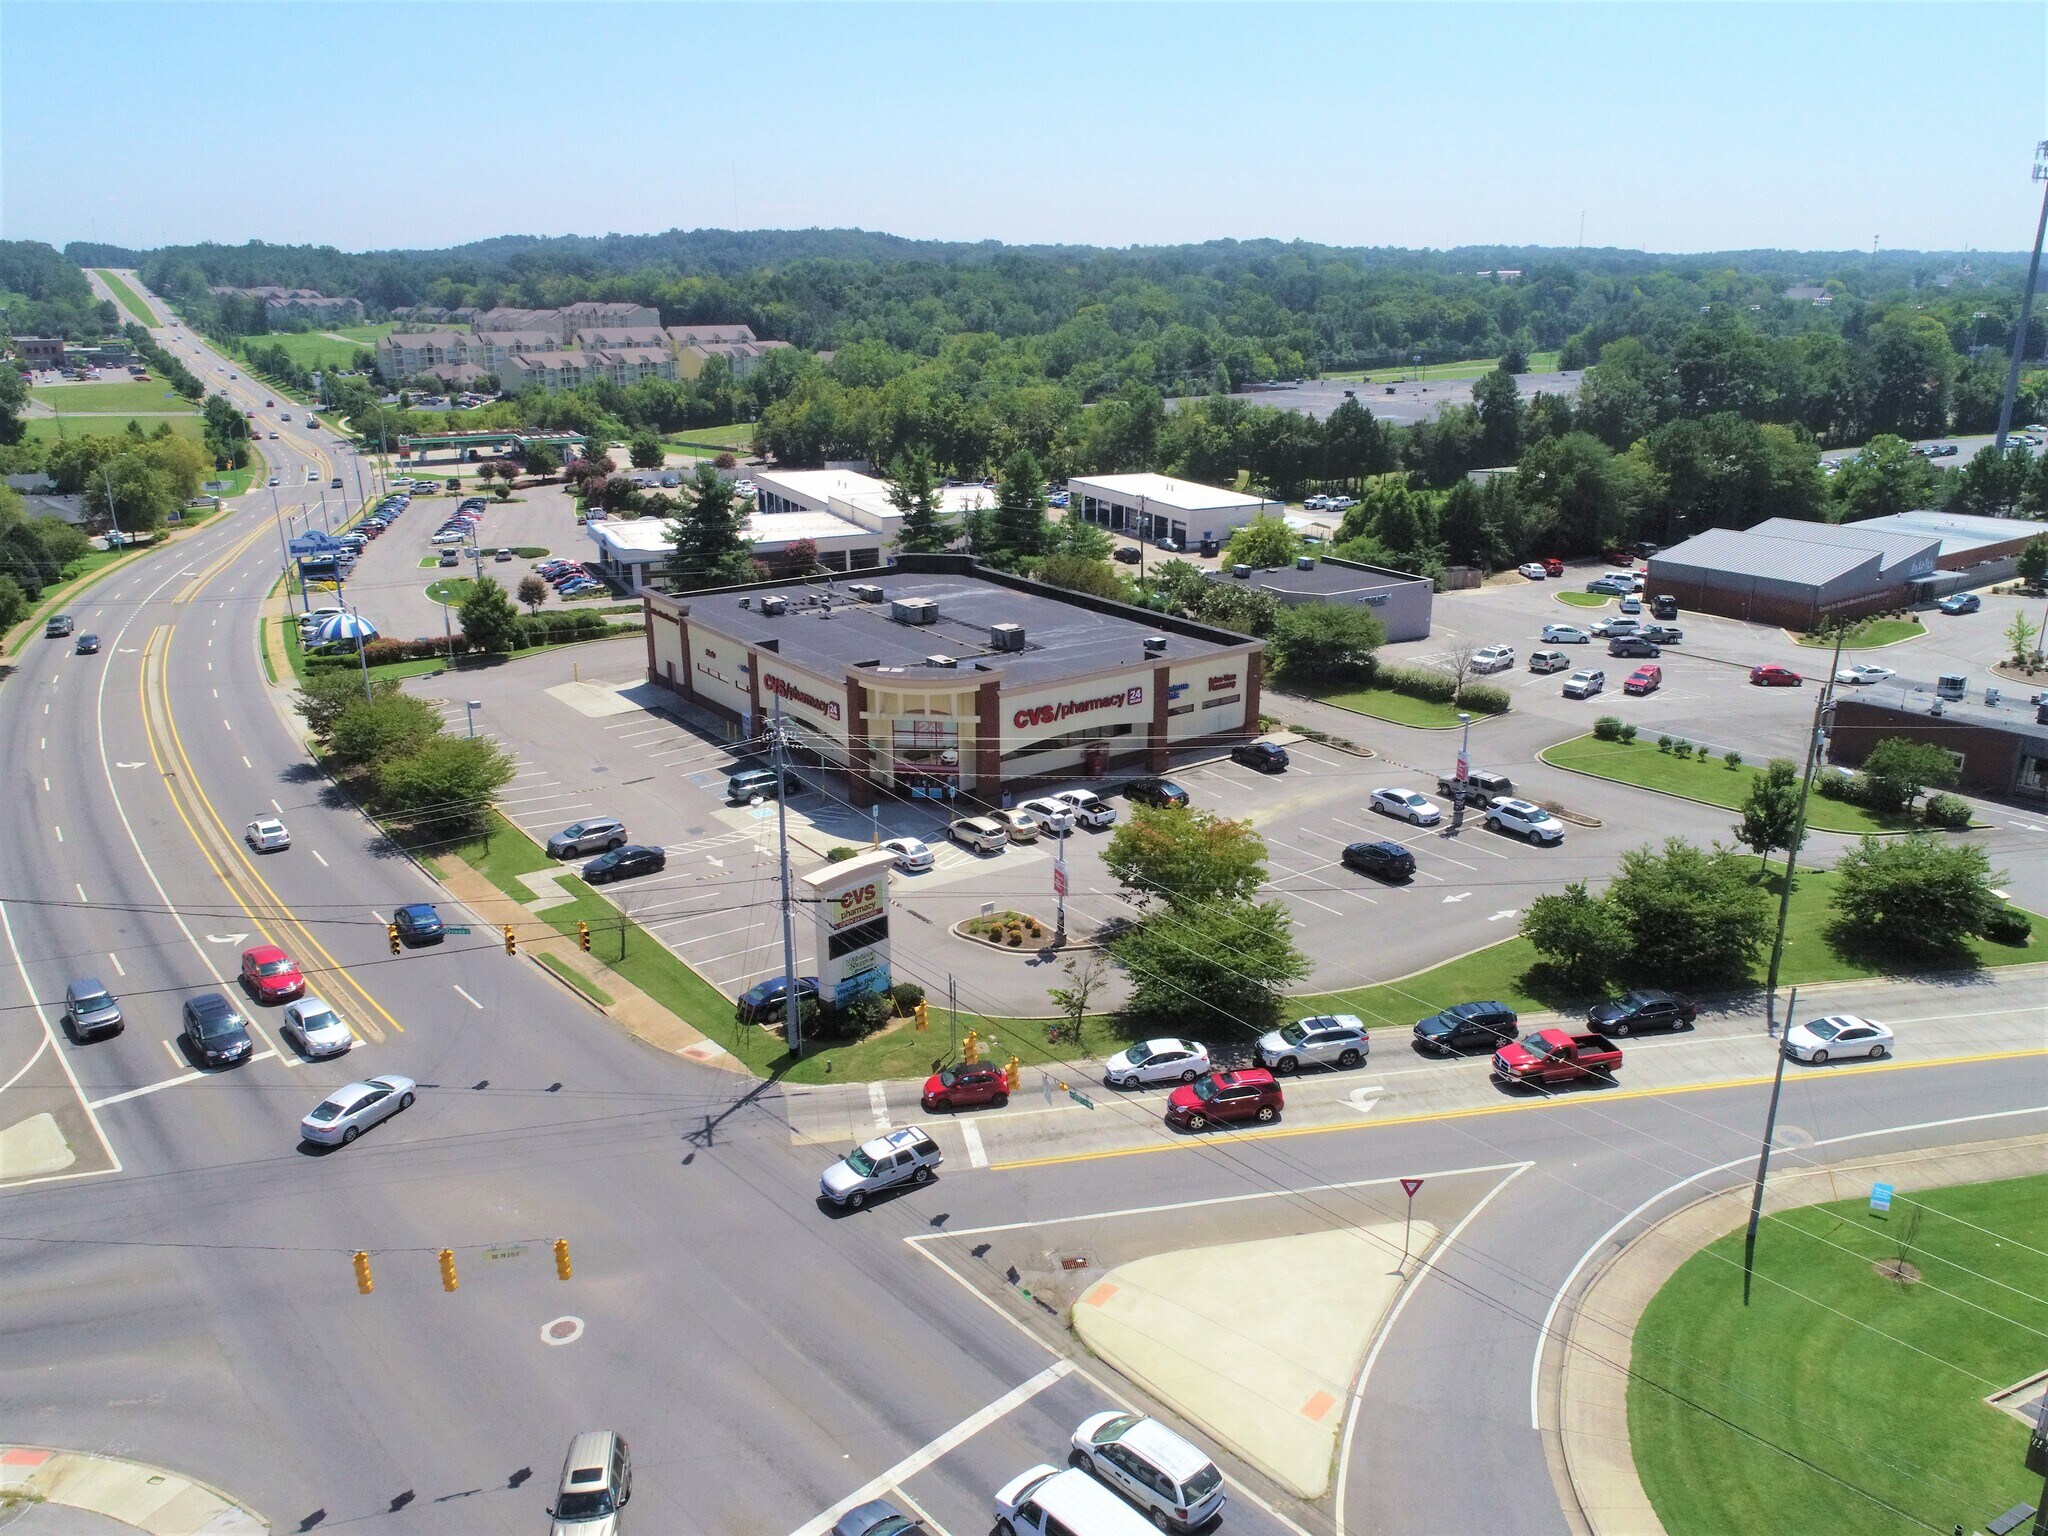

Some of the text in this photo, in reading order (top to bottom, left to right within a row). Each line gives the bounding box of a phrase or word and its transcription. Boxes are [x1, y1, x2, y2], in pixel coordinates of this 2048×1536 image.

[1129, 689, 1141, 700] 24
[829, 703, 839, 715] 24
[841, 884, 876, 909] CVS
[841, 901, 876, 920] pharmacy
